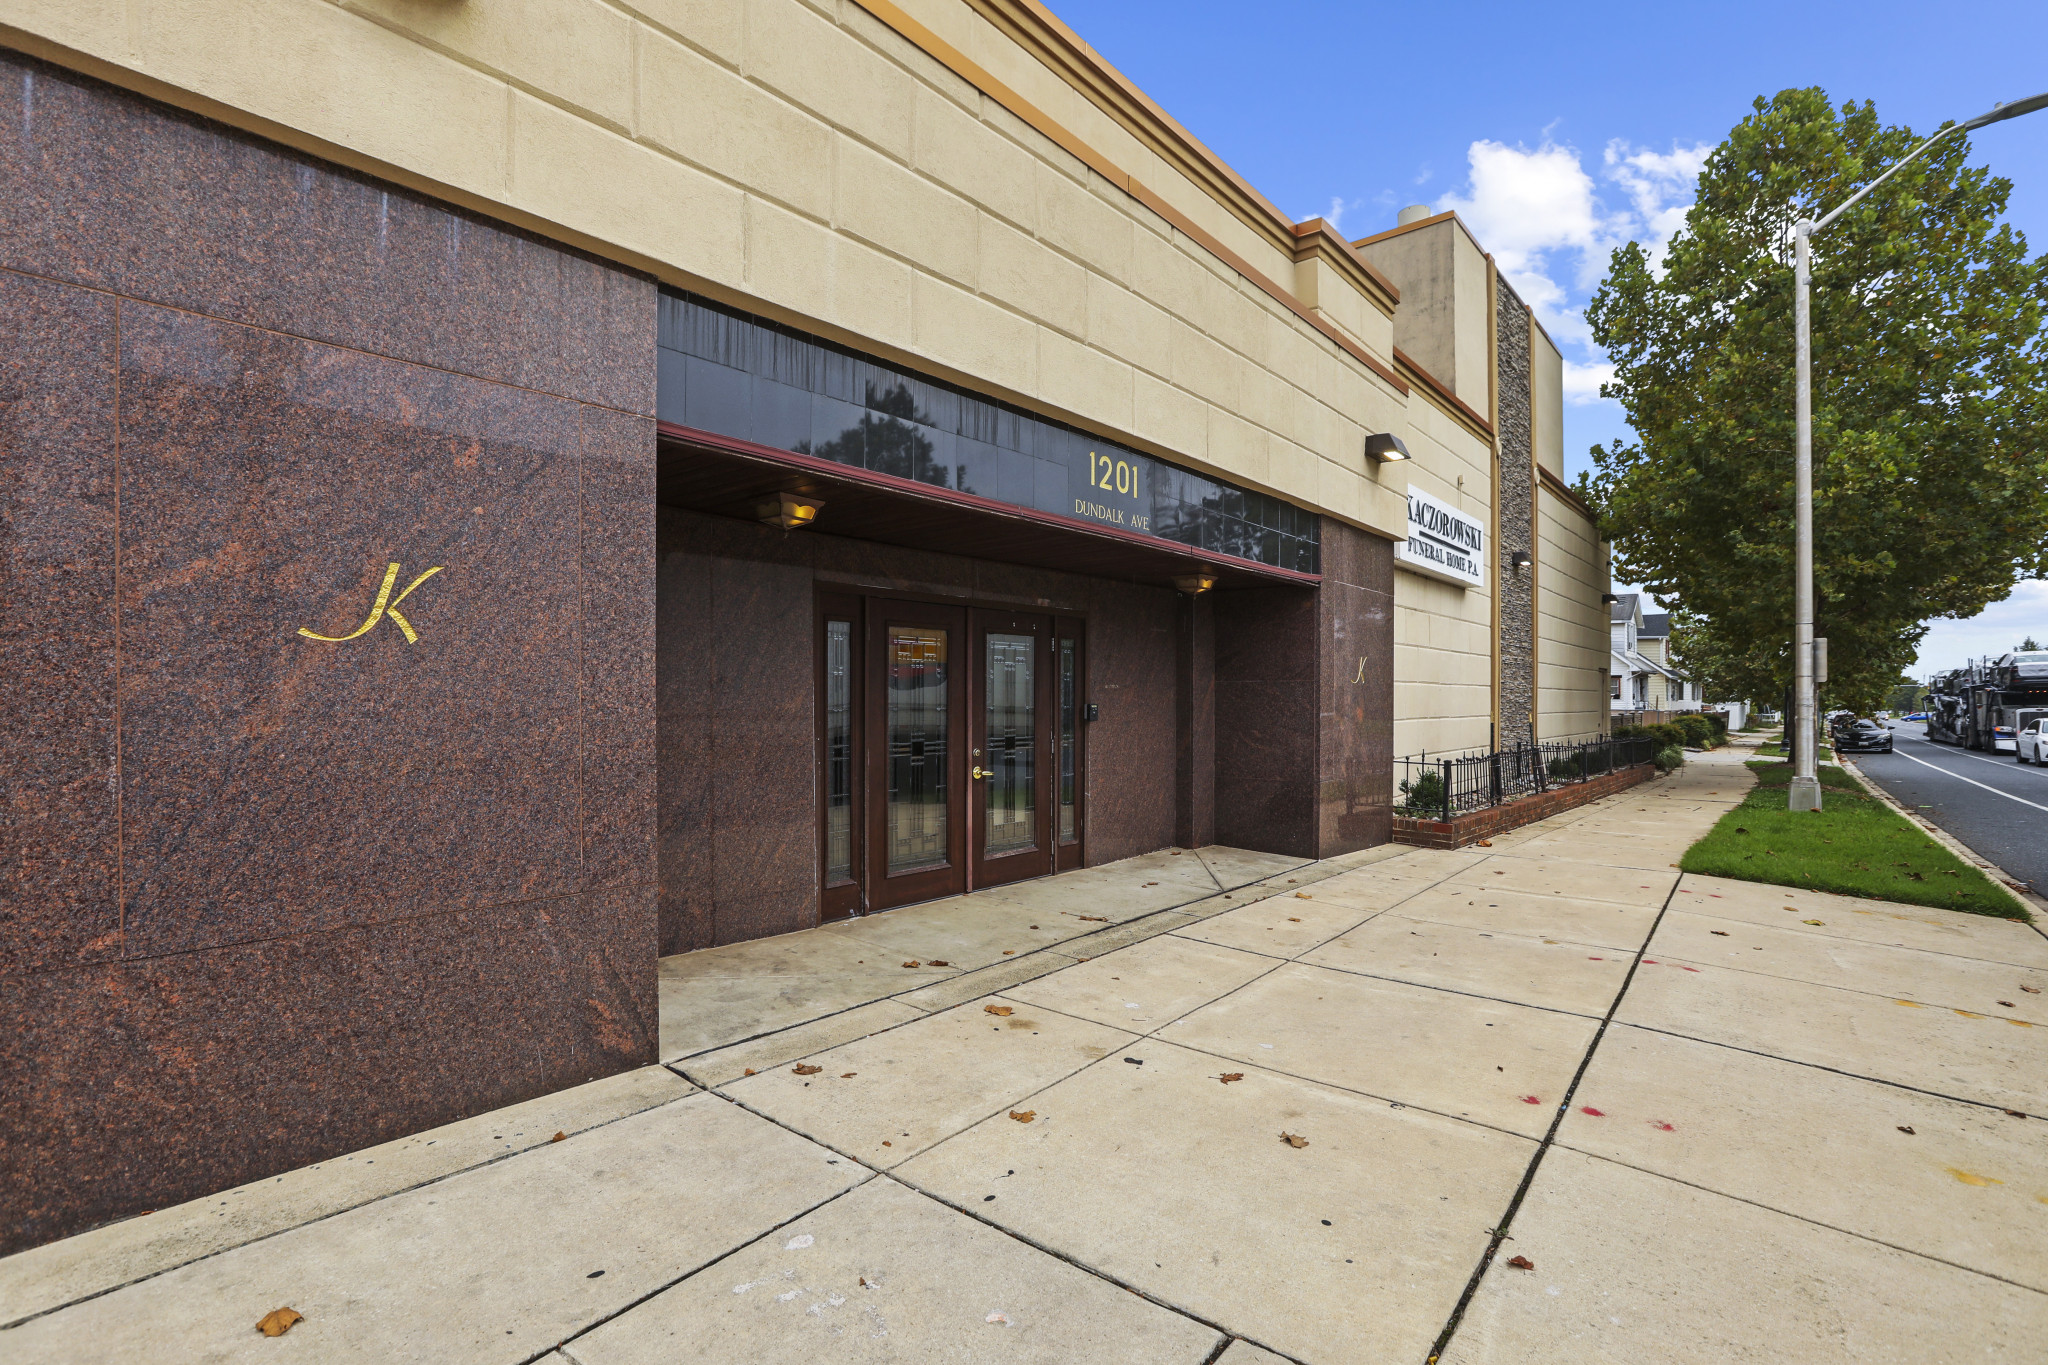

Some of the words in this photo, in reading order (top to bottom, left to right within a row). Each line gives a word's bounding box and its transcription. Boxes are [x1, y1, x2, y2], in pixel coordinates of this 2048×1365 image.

[1090, 452, 1138, 499] 1201
[1075, 499, 1124, 524] DUNDALK
[1408, 535, 1445, 564] FUNERAL
[1446, 551, 1466, 571] HOME
